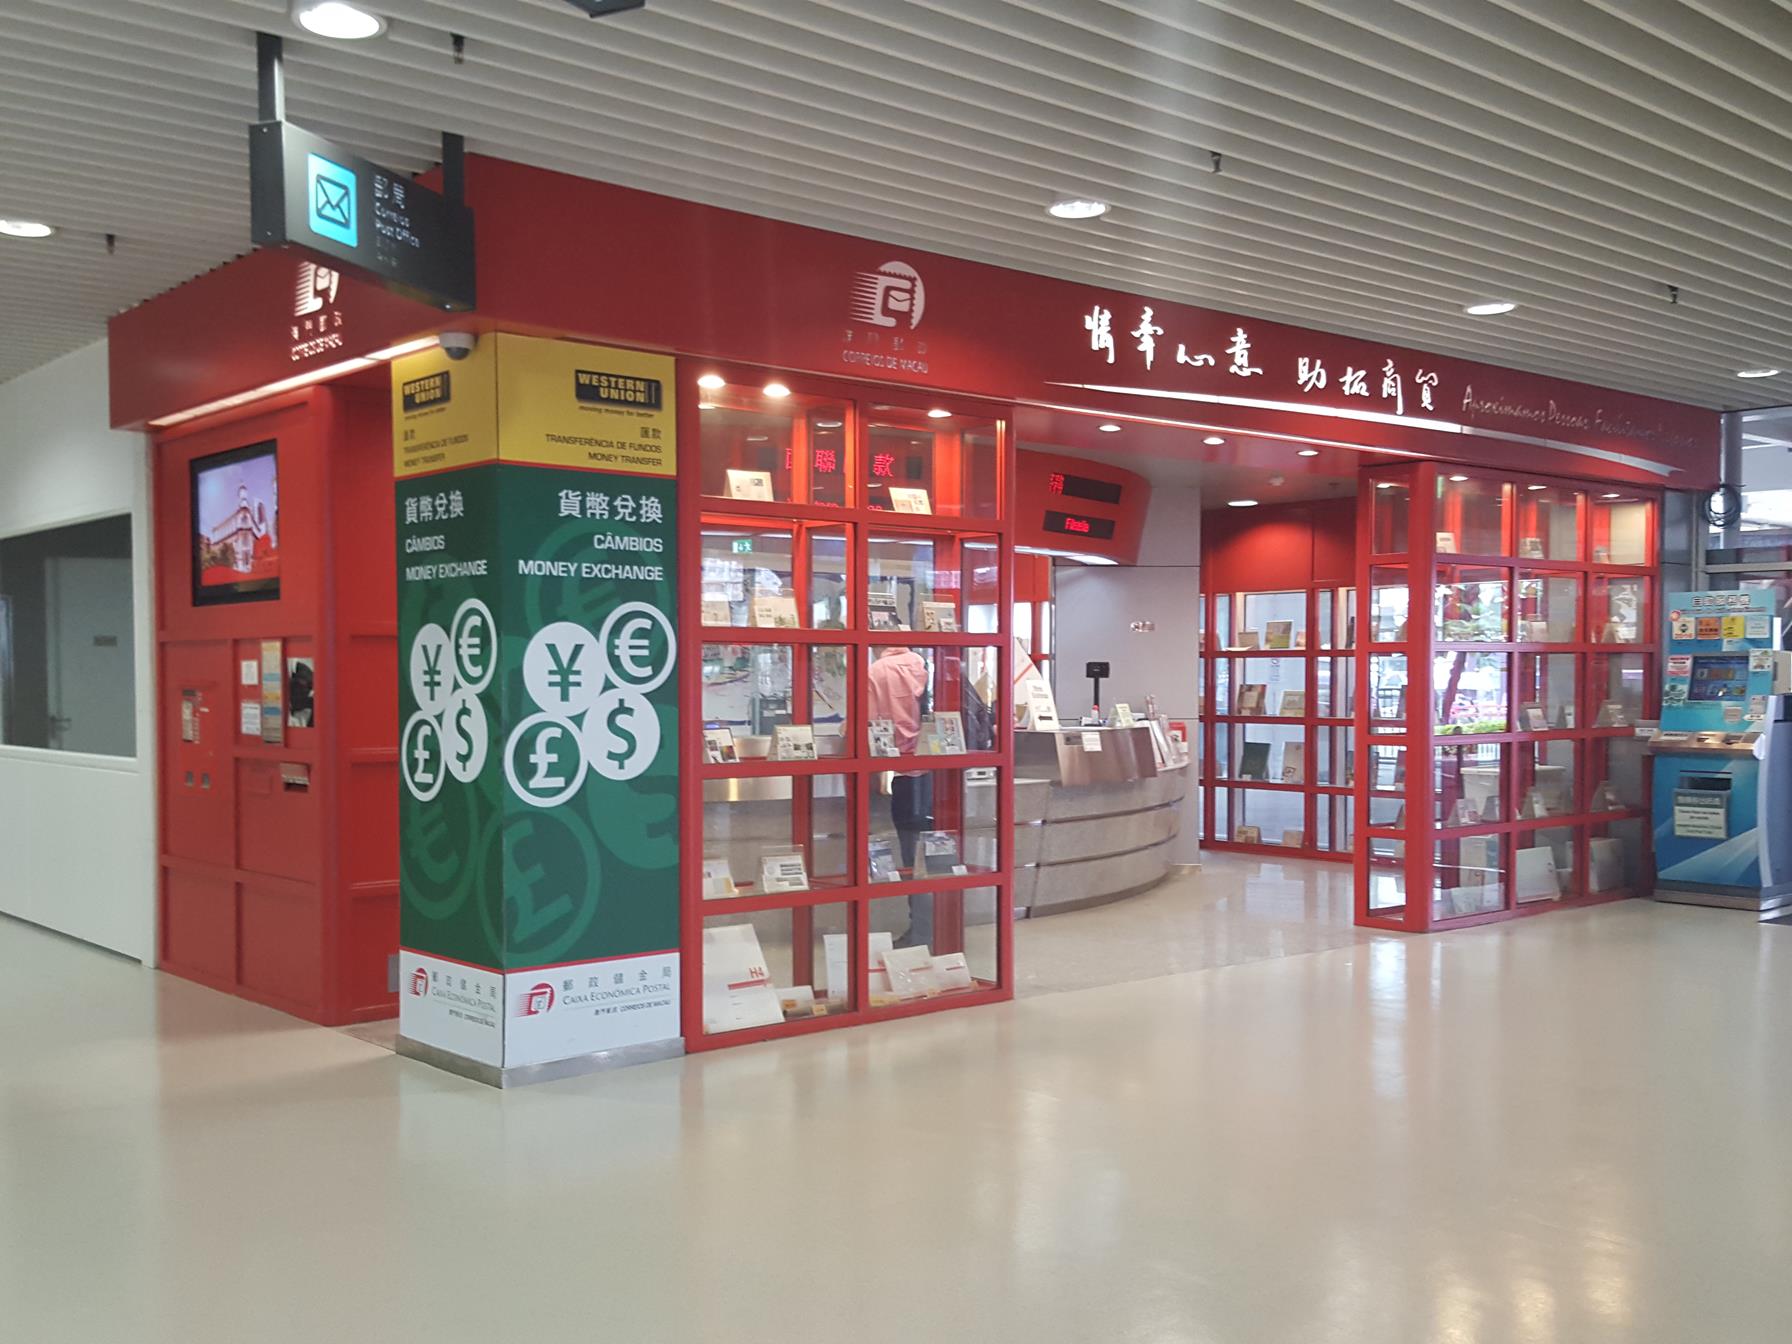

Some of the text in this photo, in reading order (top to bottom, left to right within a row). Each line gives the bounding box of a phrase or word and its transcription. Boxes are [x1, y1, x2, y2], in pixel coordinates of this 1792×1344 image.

[404, 375, 443, 396] WESTERN
[577, 372, 646, 391] WESTERN
[599, 387, 646, 403] UNION
[616, 441, 627, 450] DE
[629, 442, 663, 454] FUNDOS
[588, 451, 663, 467] MONEY TRANSFER
[558, 489, 663, 524] 貨幣兌換
[593, 532, 663, 552] CÂMBIOS
[405, 560, 488, 580] MONEY EXCHANGE
[518, 559, 664, 581] MONEY EXCHANGE
